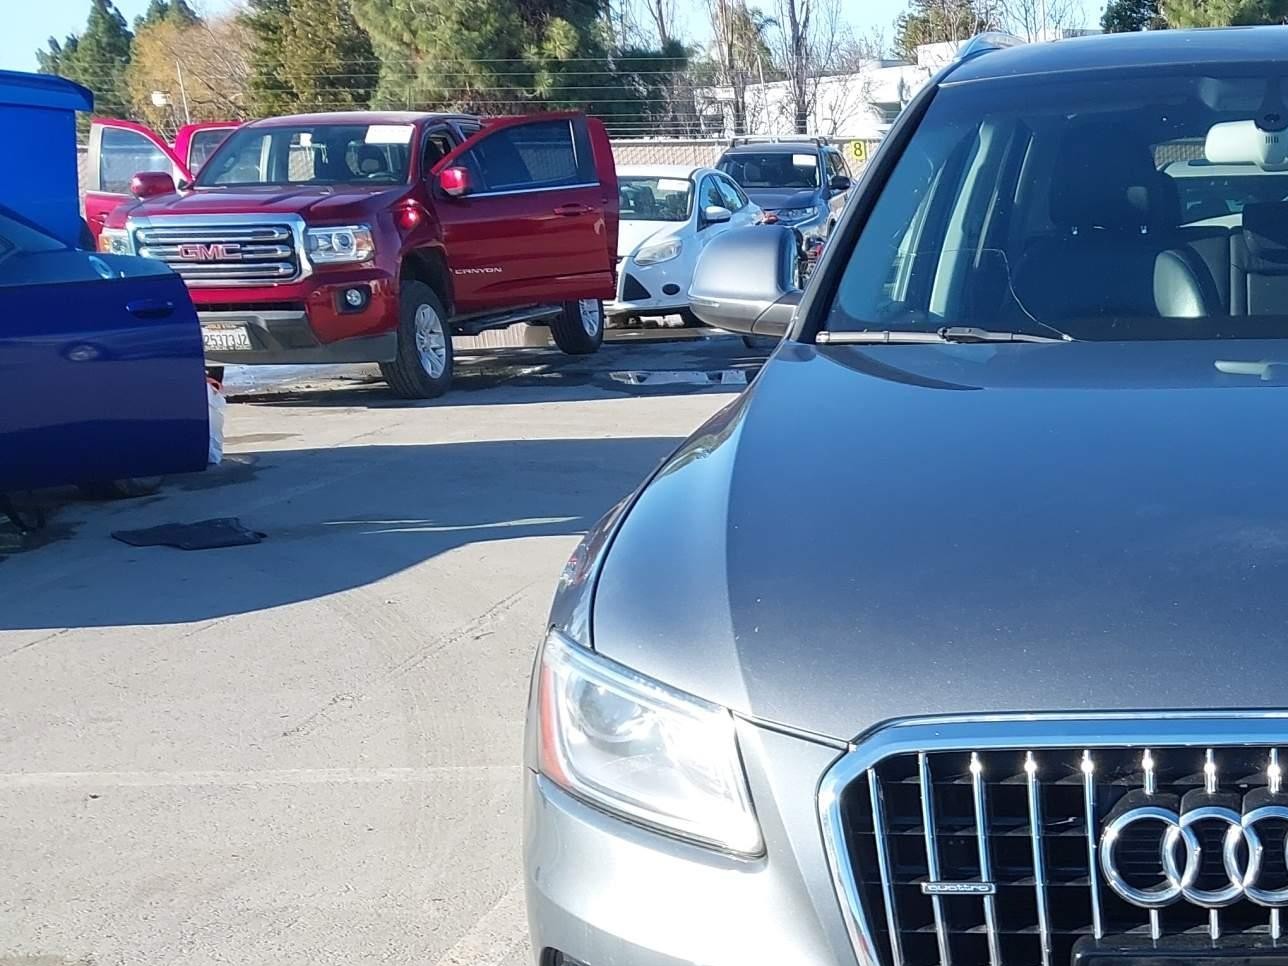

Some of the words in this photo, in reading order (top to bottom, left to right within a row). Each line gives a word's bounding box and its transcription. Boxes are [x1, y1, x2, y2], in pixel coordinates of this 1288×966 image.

[853, 142, 863, 157] 8
[177, 244, 242, 260] GMC
[454, 267, 503, 275] CANYON
[926, 883, 991, 893] quattro
